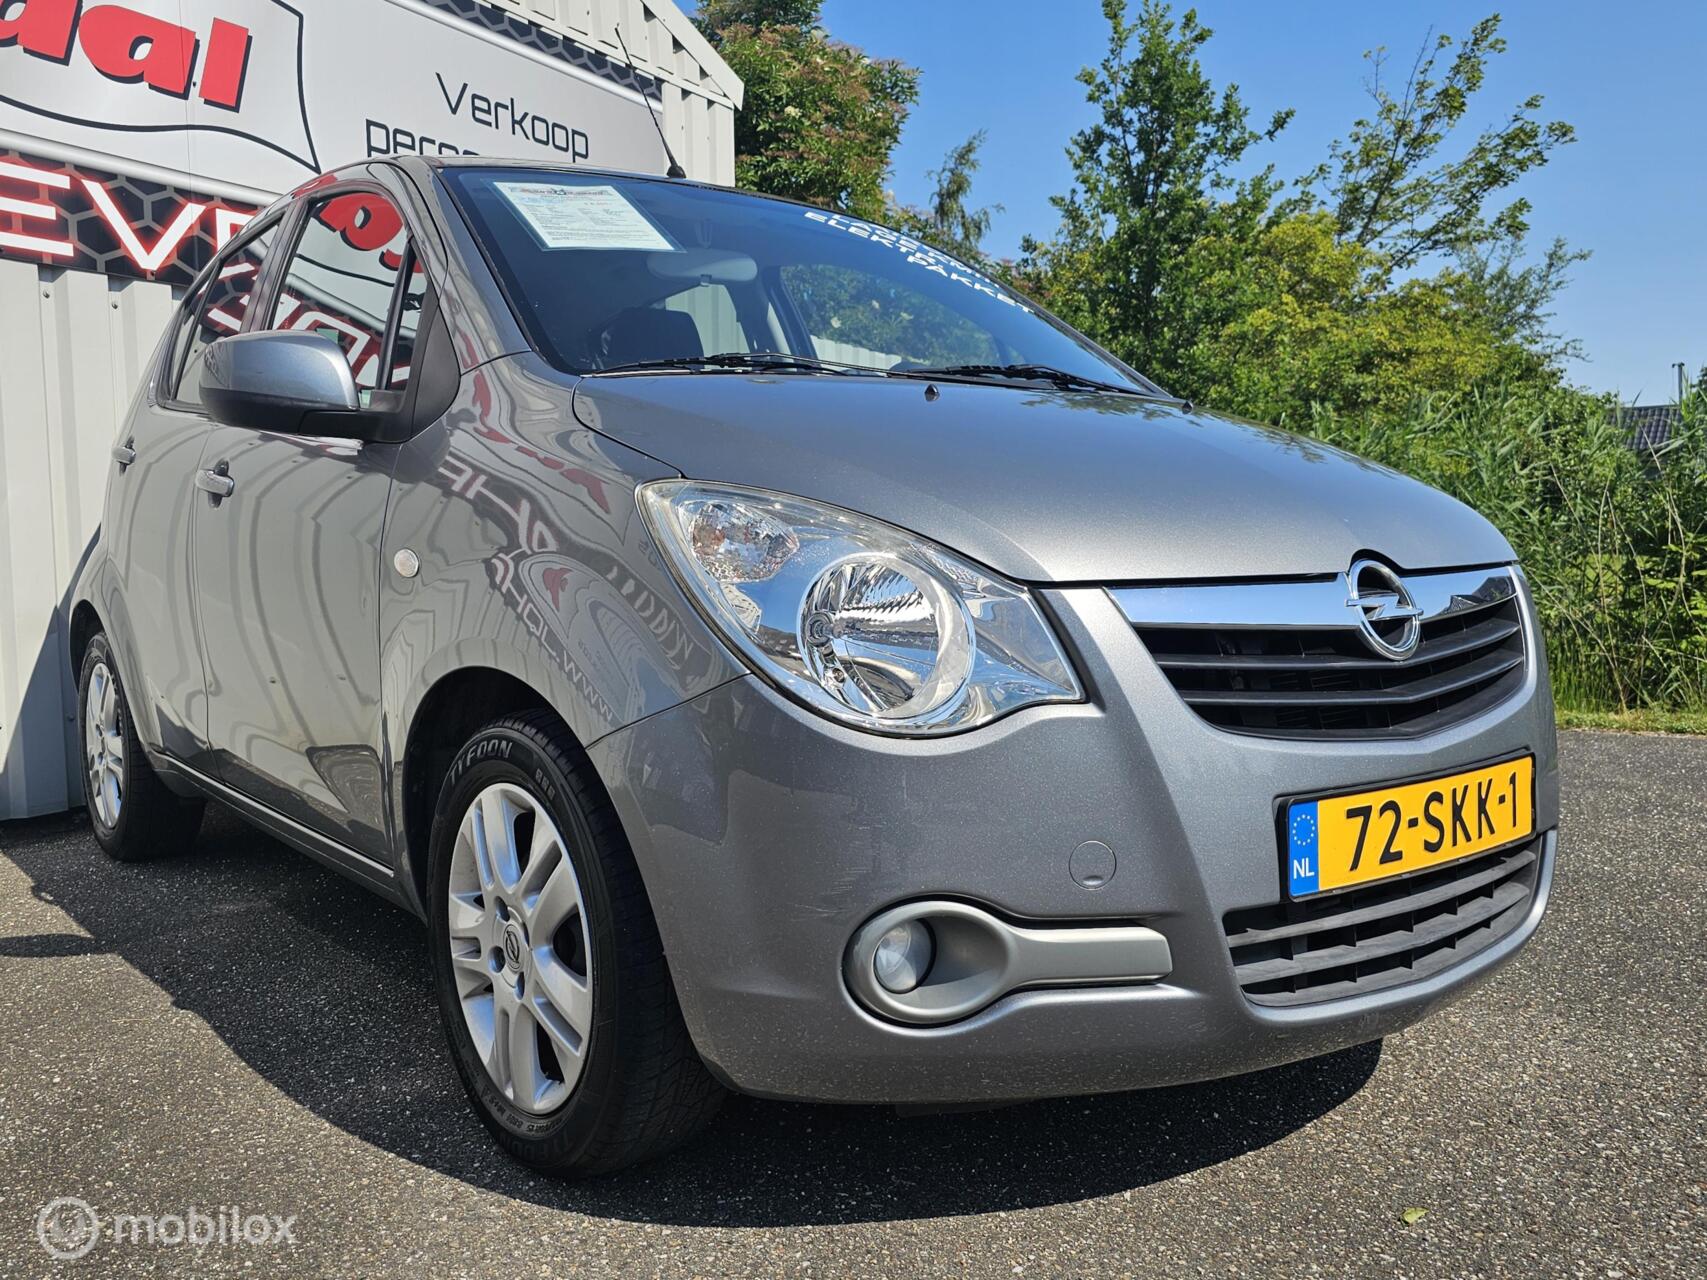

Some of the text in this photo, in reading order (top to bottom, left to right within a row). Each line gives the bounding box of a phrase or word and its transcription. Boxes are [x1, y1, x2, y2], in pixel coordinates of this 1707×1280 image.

[365, 118, 480, 157] per
[435, 71, 589, 163] Verkoop
[907, 254, 1035, 313] PAKKET
[450, 739, 513, 786] TYFOON
[1346, 771, 1518, 872] 72-SKK-1
[1293, 858, 1315, 879] NL
